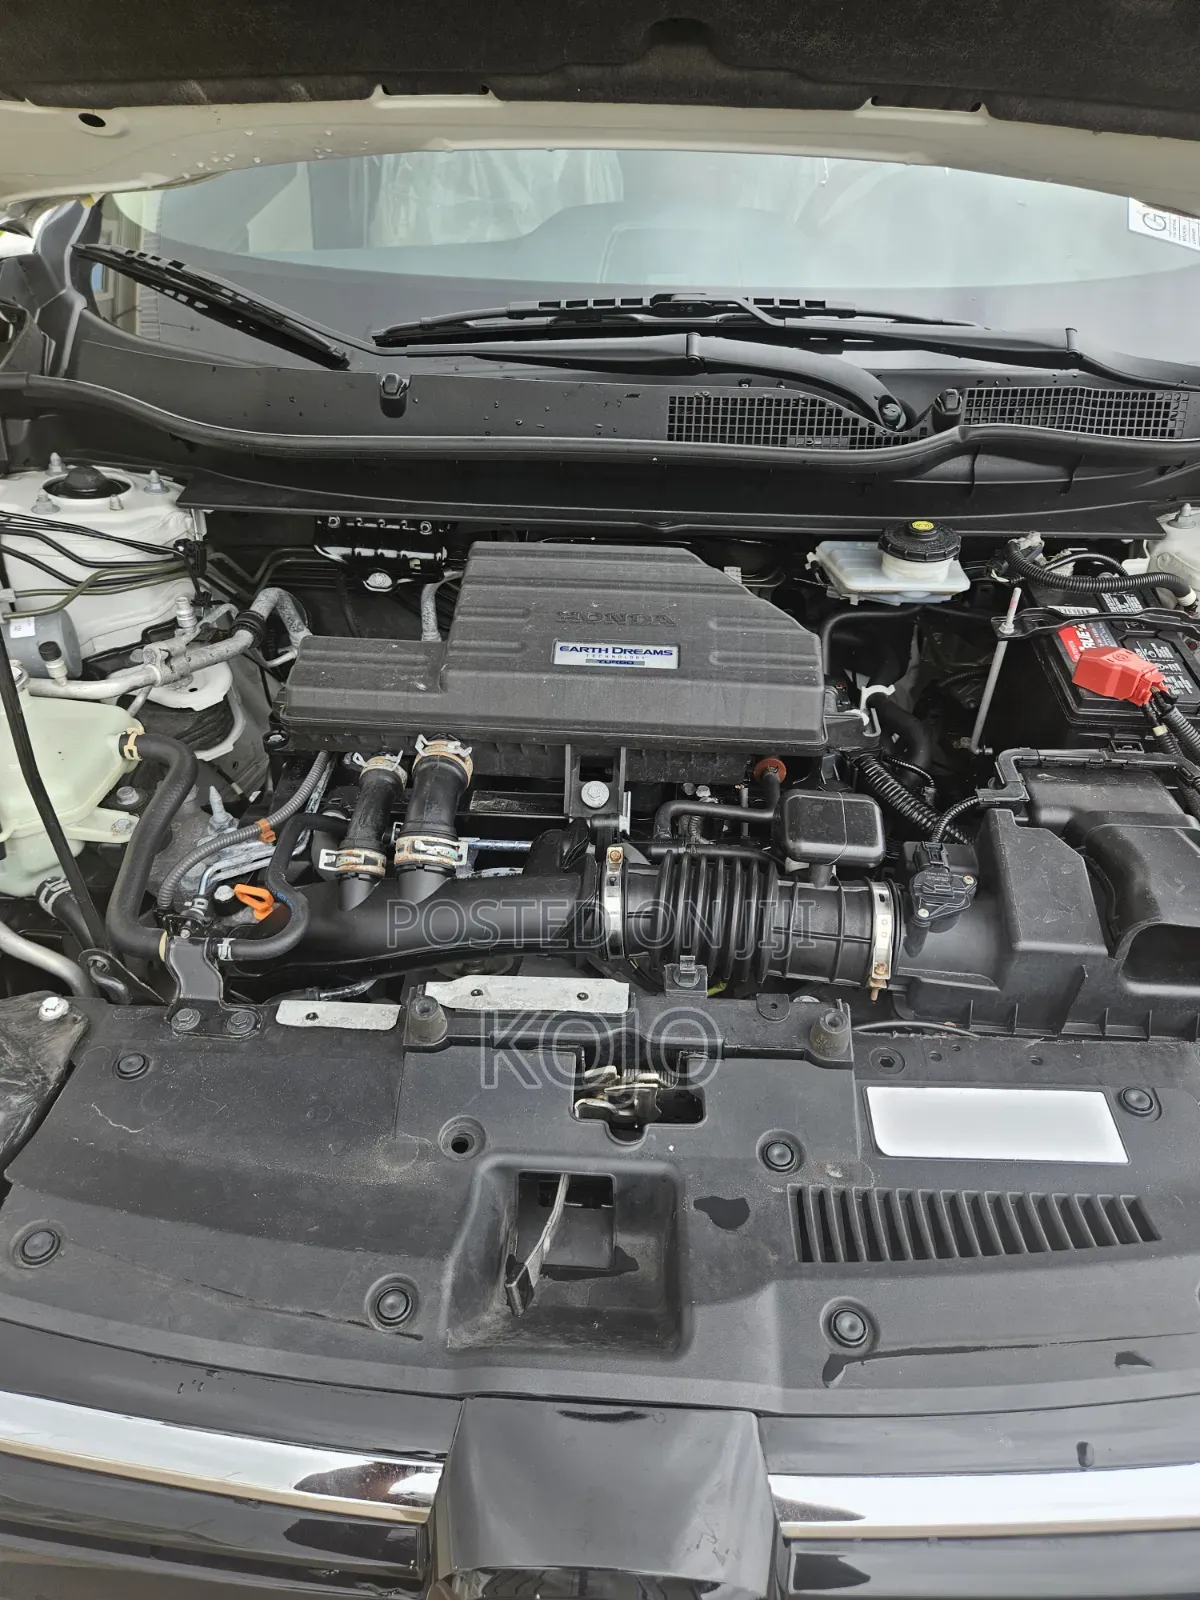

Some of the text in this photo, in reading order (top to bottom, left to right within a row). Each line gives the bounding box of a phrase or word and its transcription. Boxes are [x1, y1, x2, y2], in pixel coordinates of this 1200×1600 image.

[556, 611, 678, 628] HONDA
[559, 645, 673, 656] EARTH DREAMS
